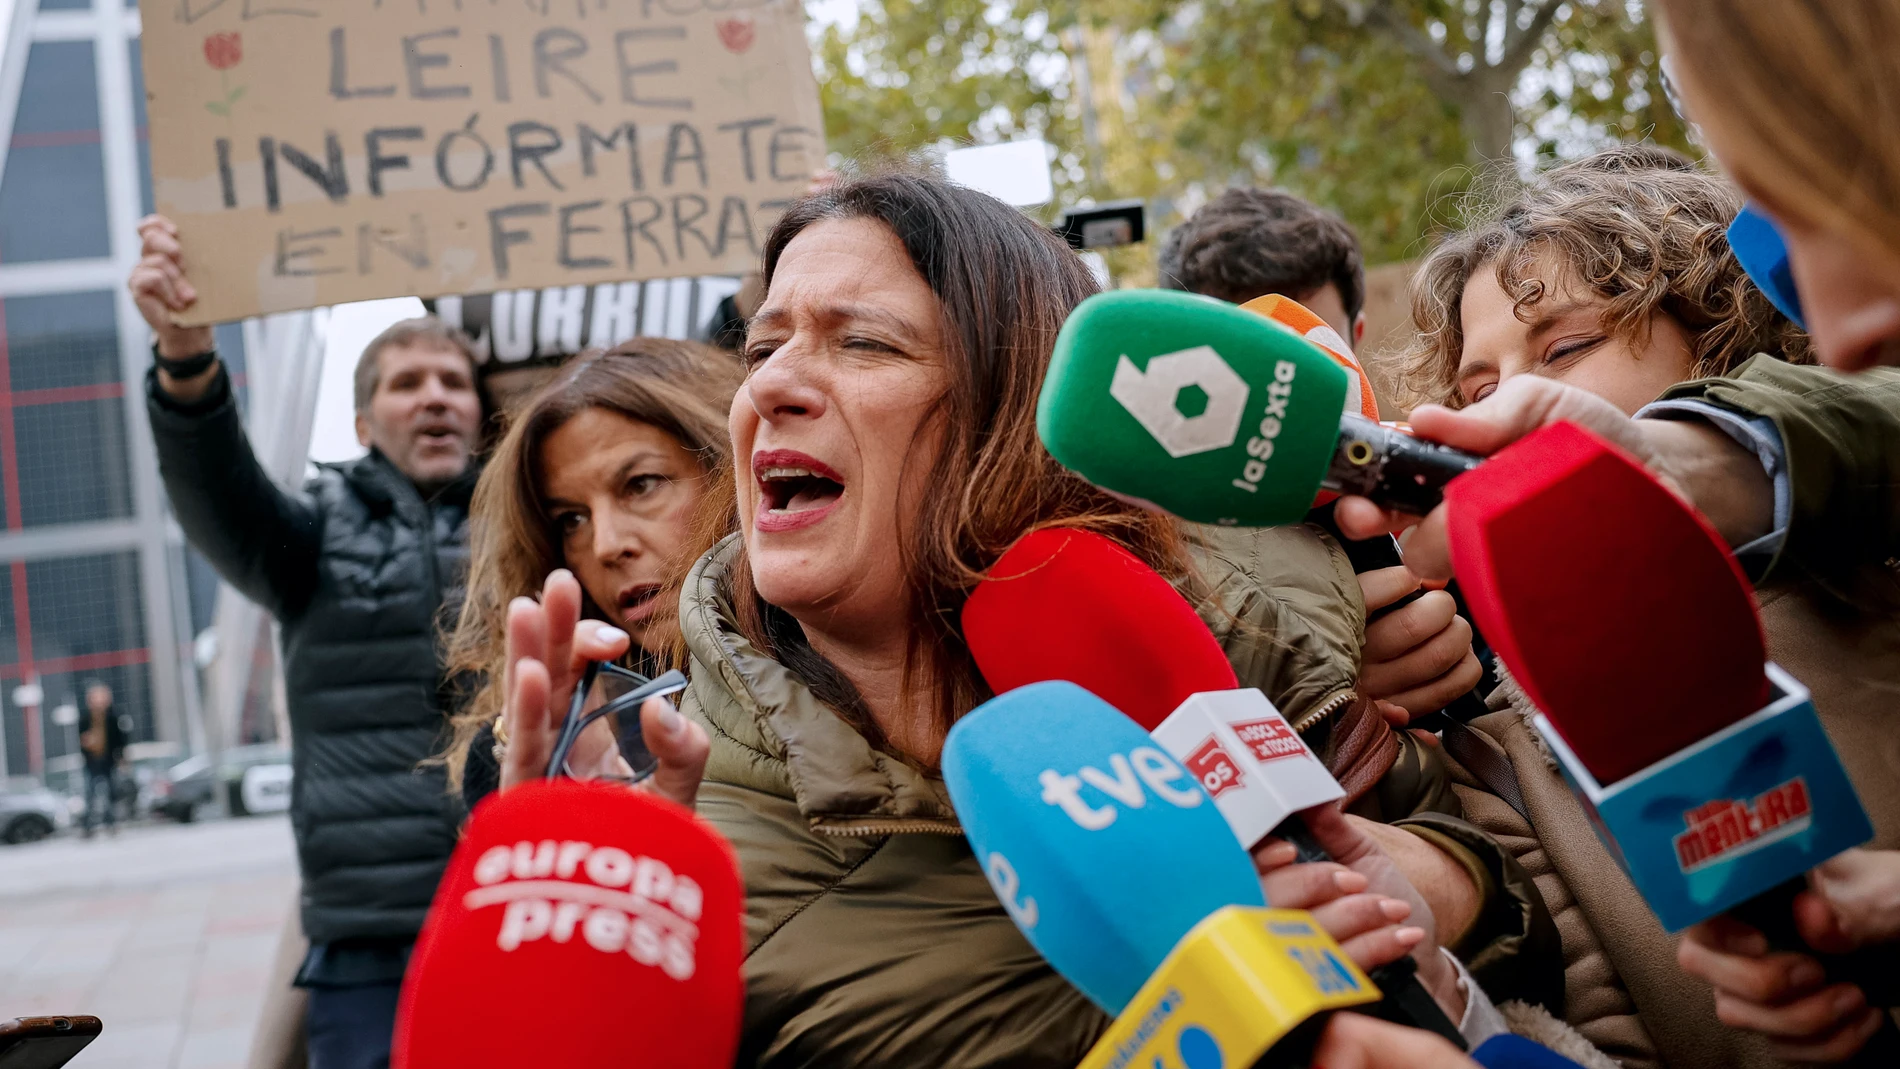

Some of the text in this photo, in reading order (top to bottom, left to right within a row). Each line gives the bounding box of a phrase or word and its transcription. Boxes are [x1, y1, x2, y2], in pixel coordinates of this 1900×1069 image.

[330, 26, 694, 110] LEIRE
[214, 113, 819, 212] INFÓRMATE
[272, 214, 434, 278] EN
[1232, 359, 1297, 494] laSexta
[1038, 746, 1205, 831] tve
[472, 839, 704, 922] europa
[495, 899, 697, 982] press
